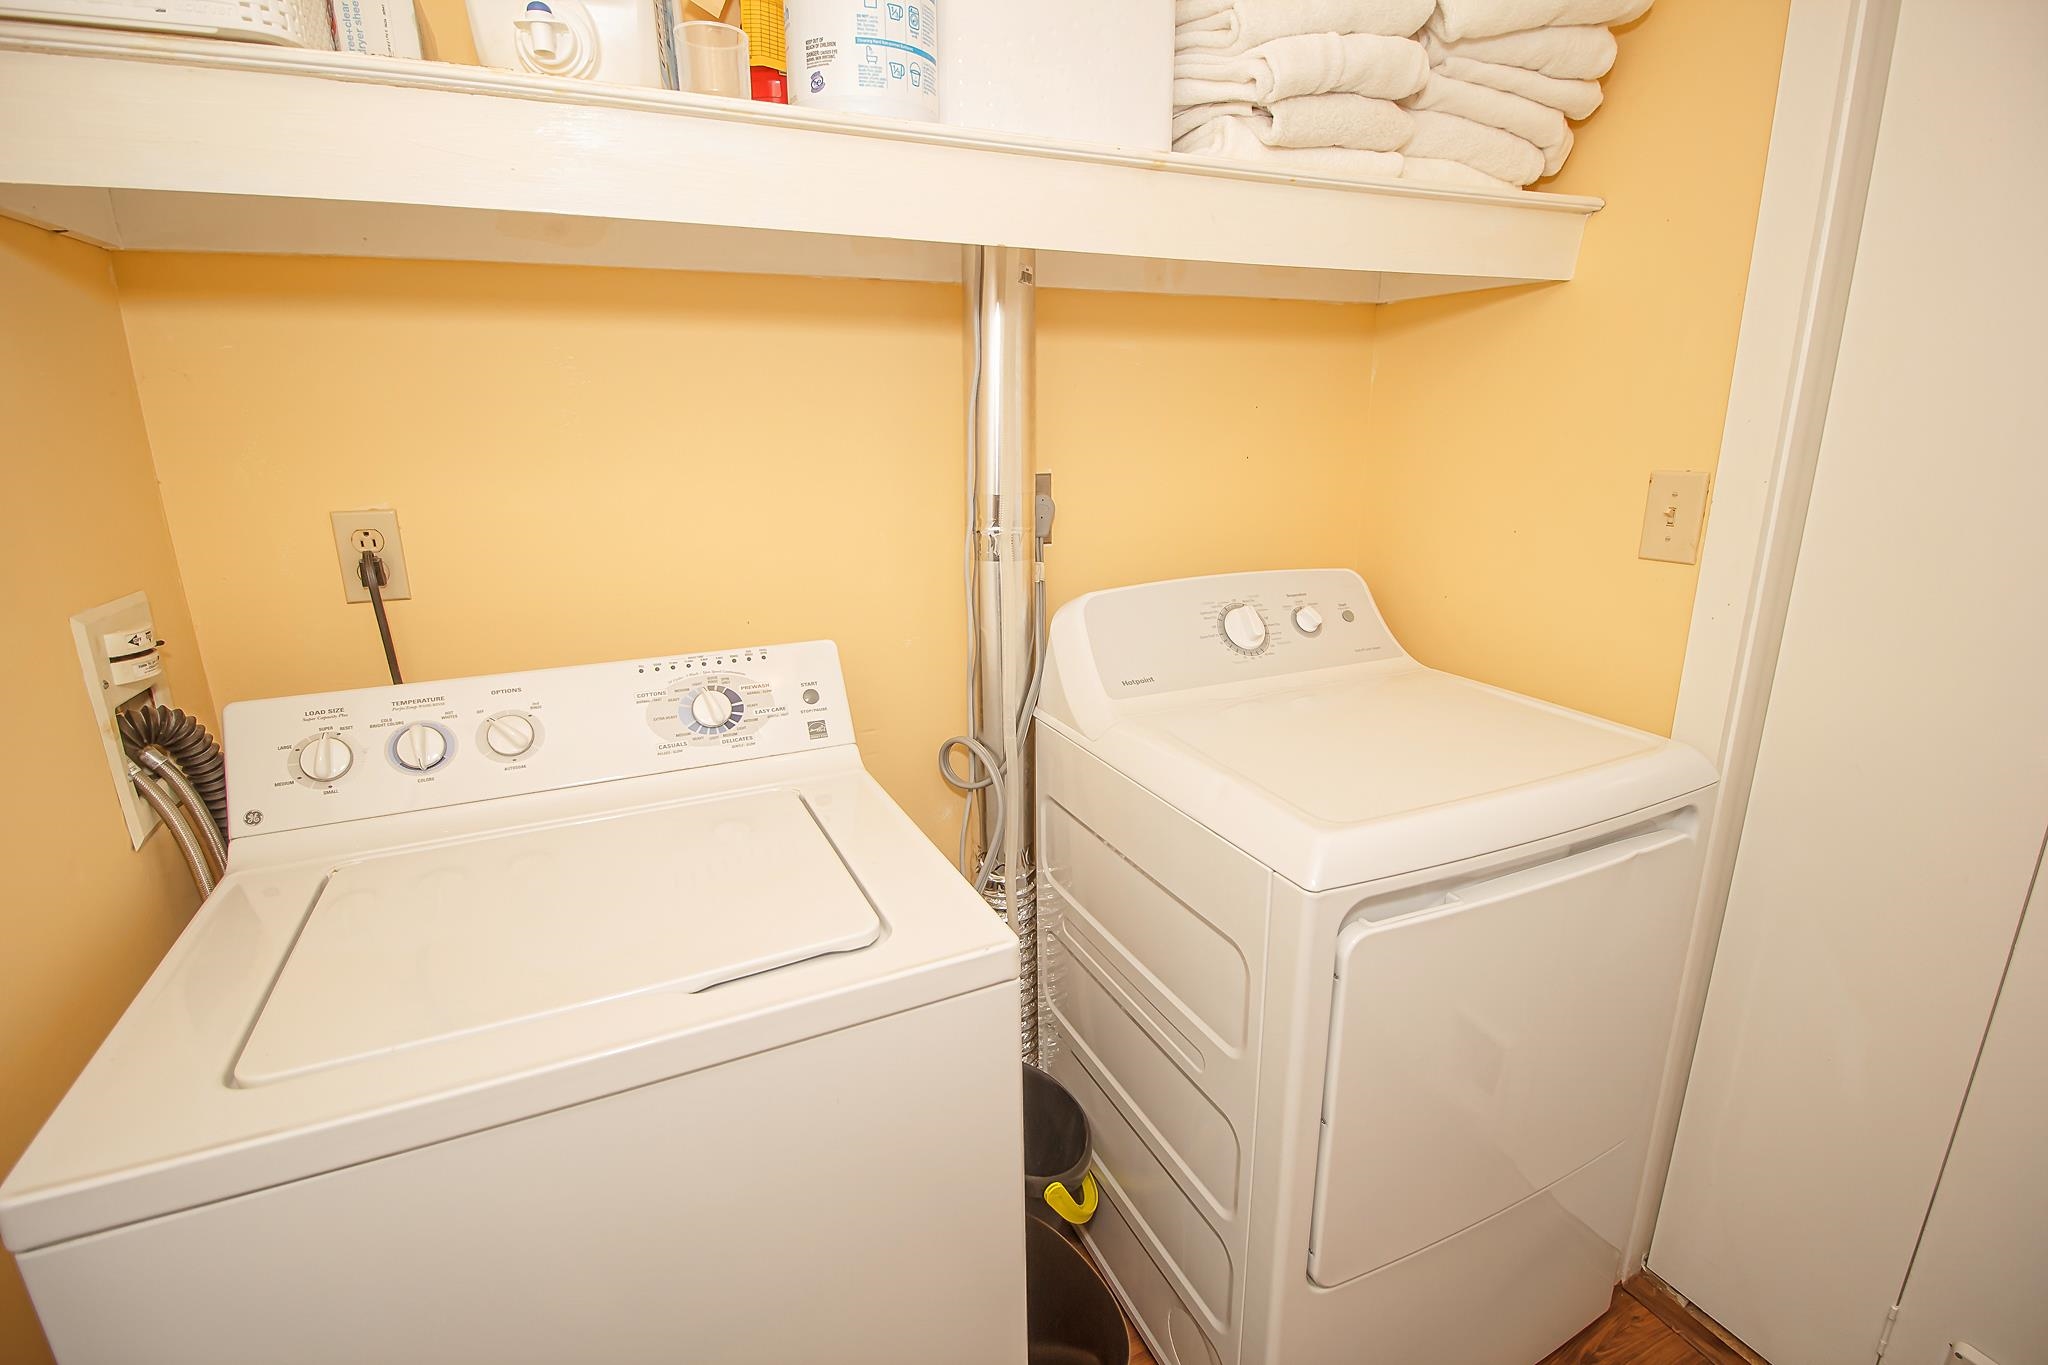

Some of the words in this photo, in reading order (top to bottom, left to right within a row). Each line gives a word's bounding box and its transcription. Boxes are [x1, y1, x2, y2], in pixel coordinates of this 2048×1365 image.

[352, 0, 362, 26] shee
[342, 1, 356, 52] ree+clear
[1121, 676, 1155, 686] Hotpoint
[490, 687, 522, 695] OPTIONS
[636, 690, 666, 699] COTTONS
[391, 696, 445, 706] TEMPERATURE
[304, 709, 326, 717] LOAD
[721, 735, 753, 744] DELICATES
[658, 741, 688, 750] CASUALS
